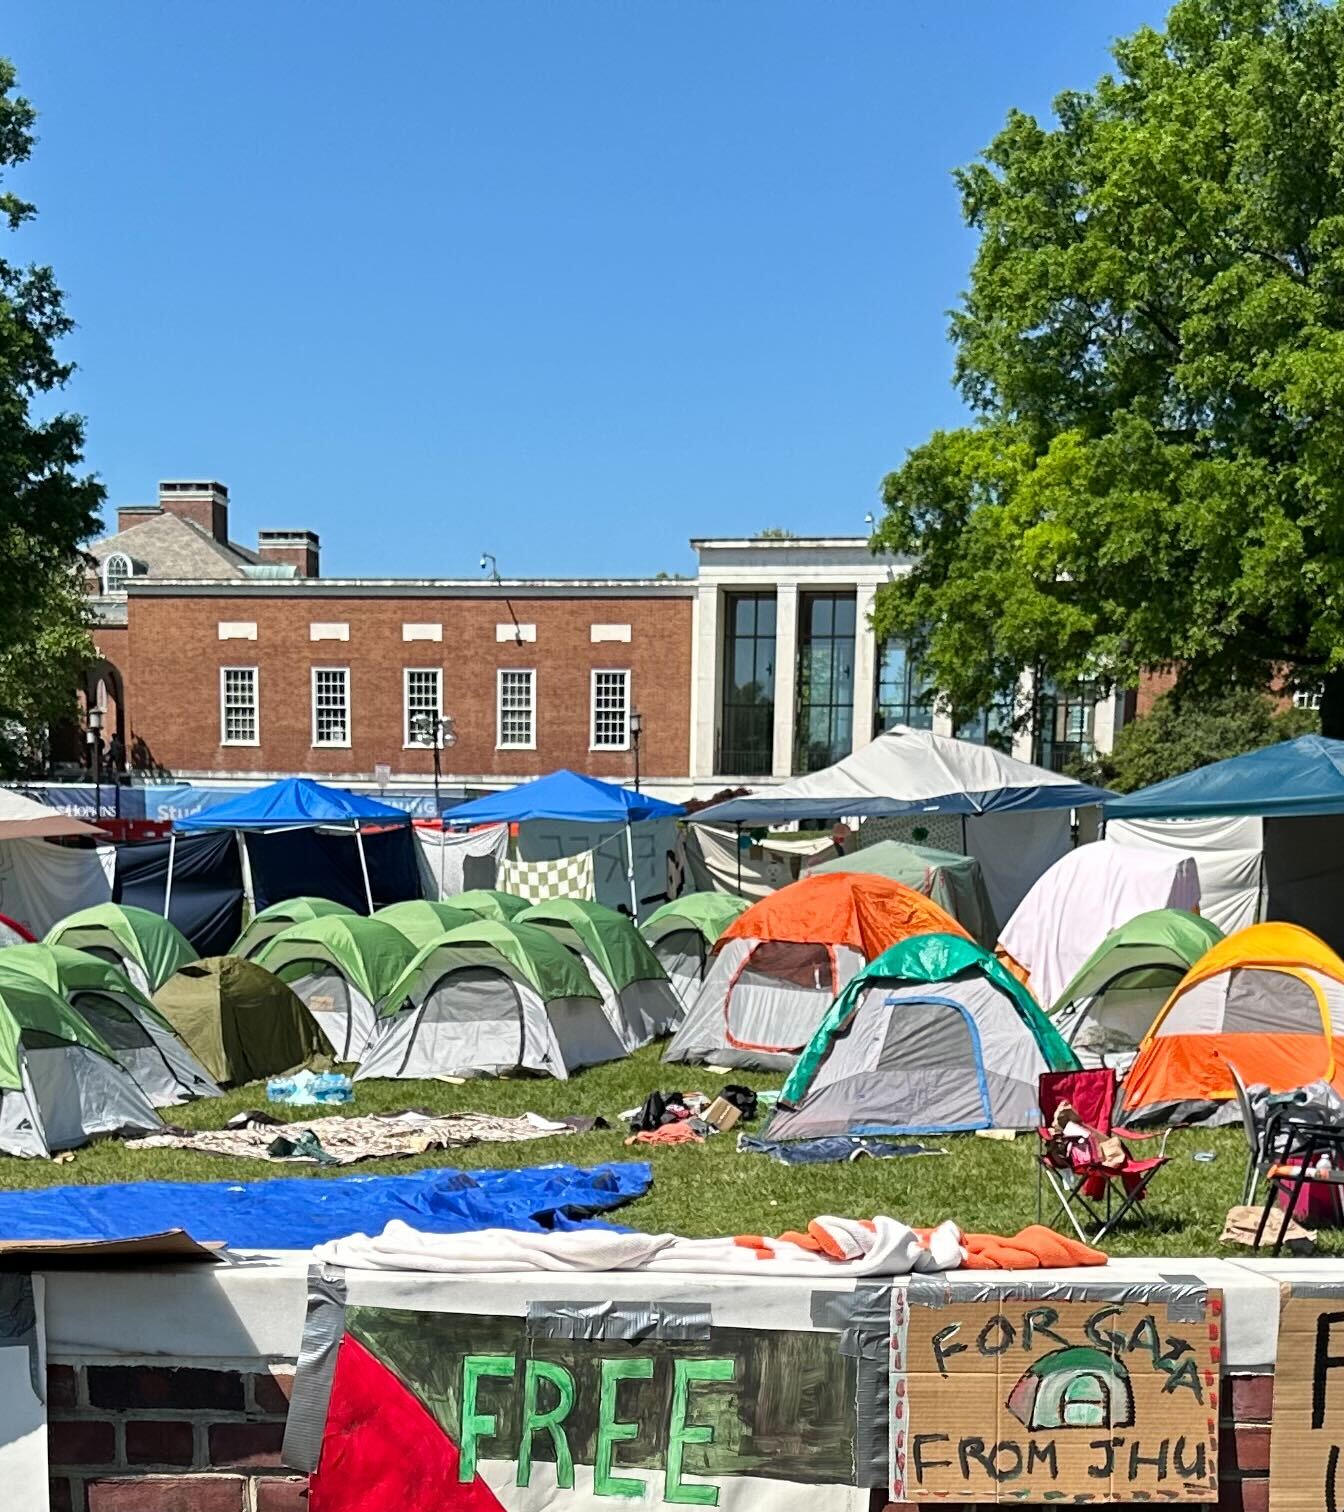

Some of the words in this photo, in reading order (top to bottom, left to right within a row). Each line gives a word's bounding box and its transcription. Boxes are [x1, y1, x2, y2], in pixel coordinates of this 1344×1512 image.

[931, 1305, 1073, 1380] FOR
[1083, 1304, 1205, 1406] GAZA
[458, 1355, 736, 1507] FREE
[912, 1433, 1059, 1485] FROM
[1087, 1435, 1206, 1483] JHU
